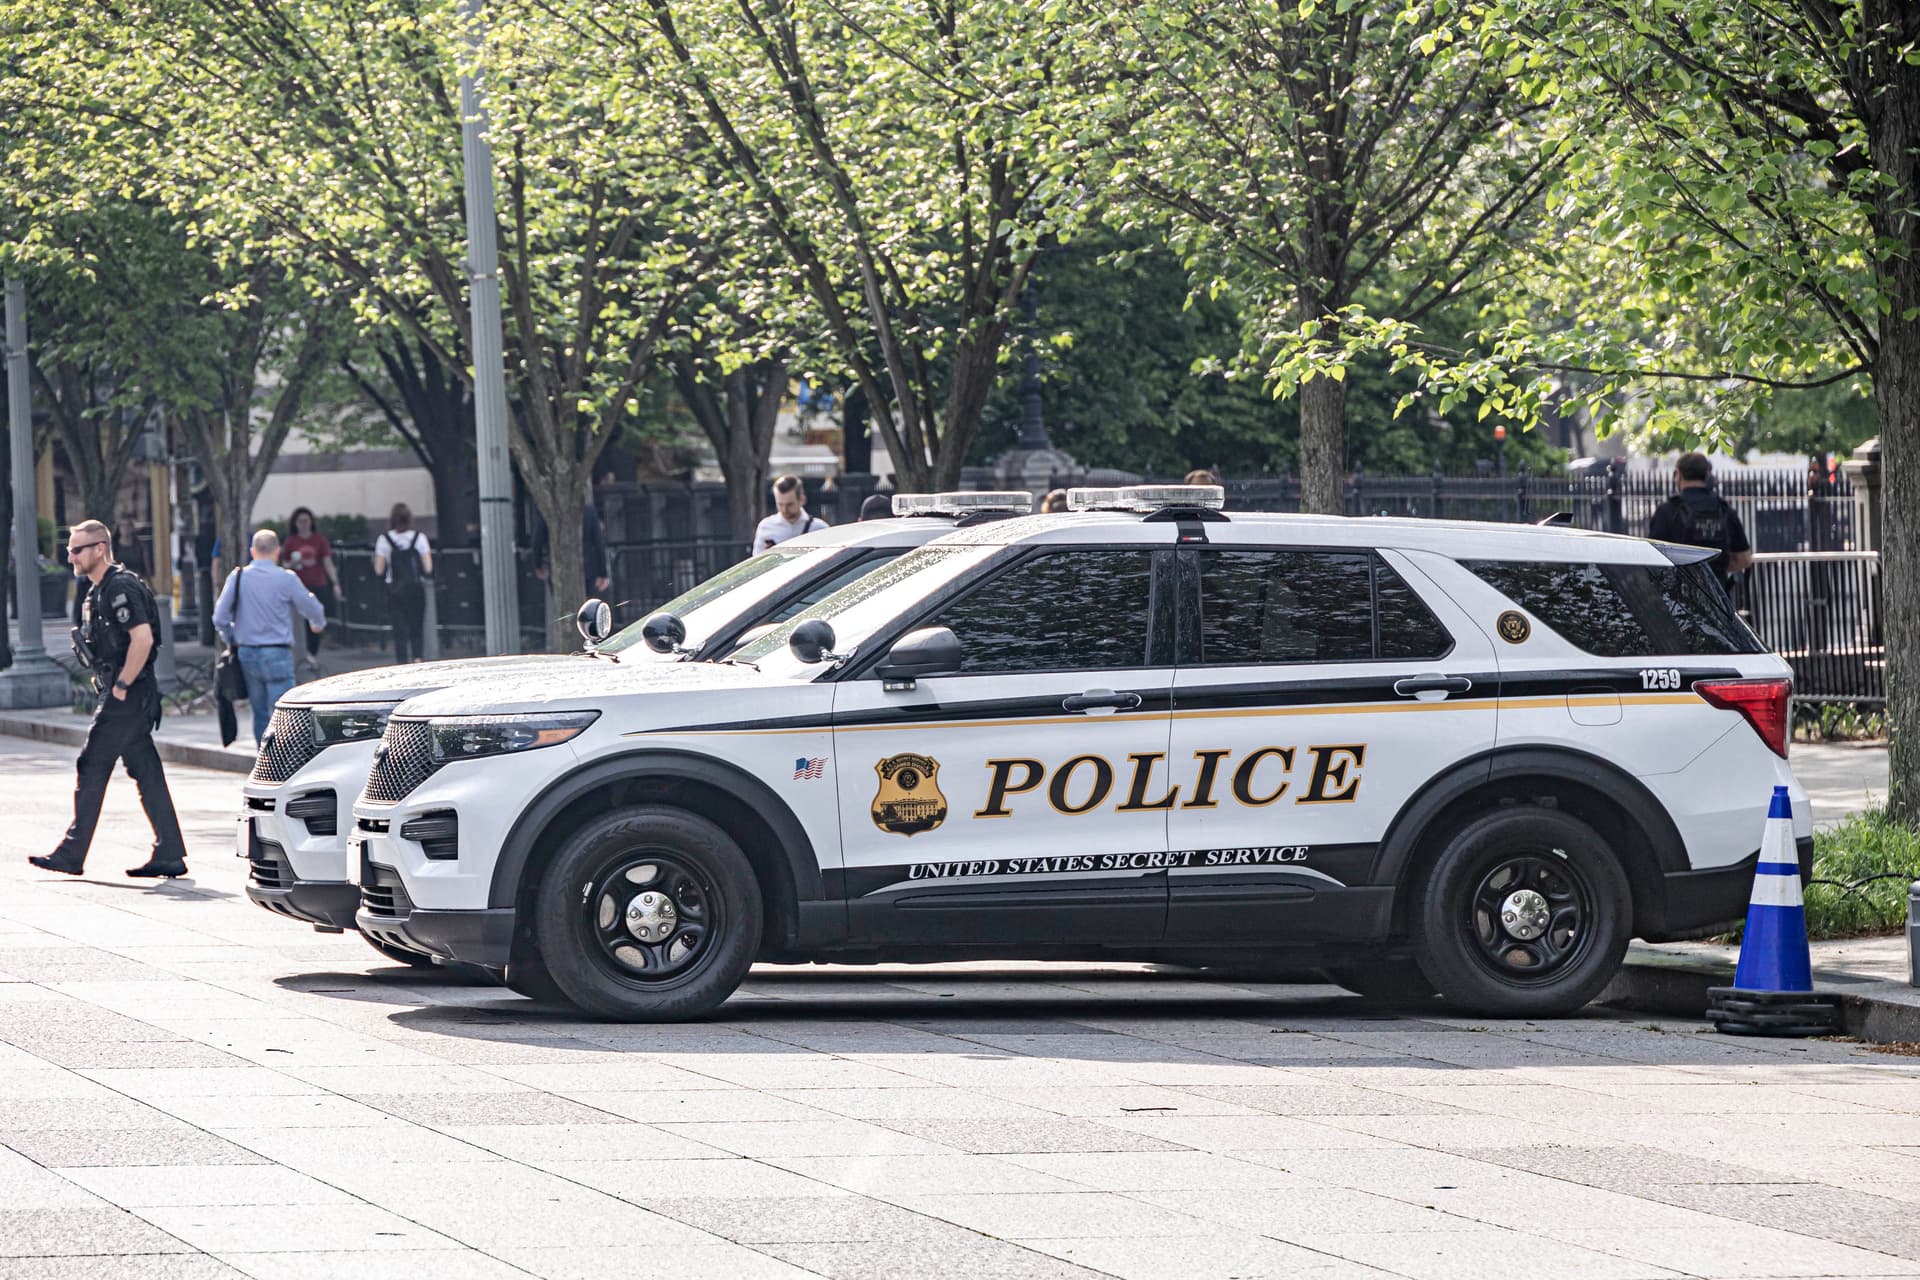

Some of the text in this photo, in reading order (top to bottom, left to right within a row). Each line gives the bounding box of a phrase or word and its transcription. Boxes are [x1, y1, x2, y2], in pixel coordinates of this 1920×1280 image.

[1639, 669, 1681, 689] 1259
[973, 743, 1367, 819] POLICE
[908, 846, 1309, 880] UNITED STATES SECRET SERVICE
